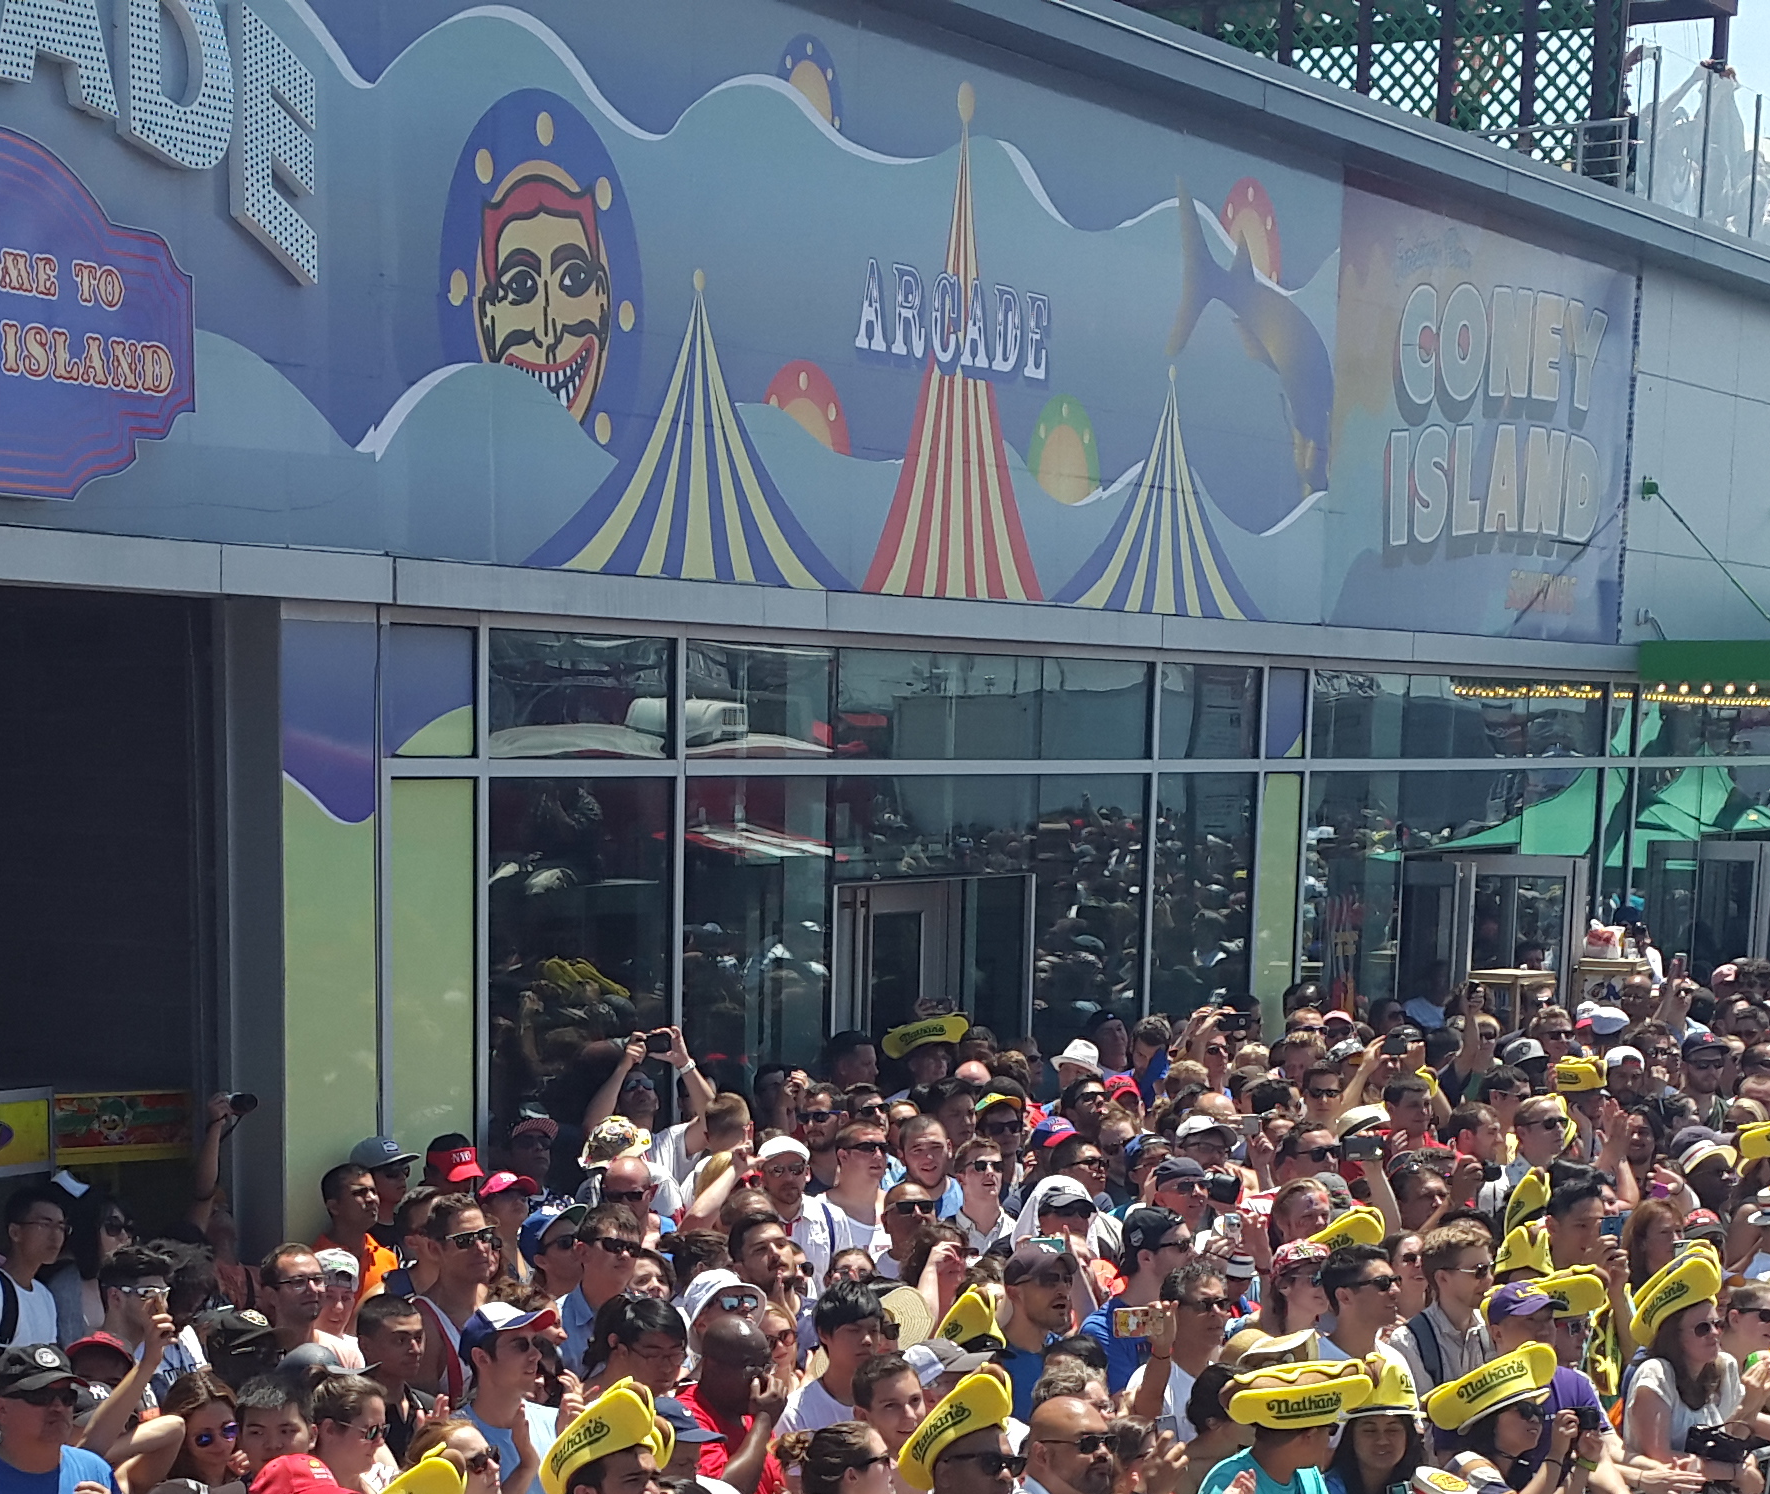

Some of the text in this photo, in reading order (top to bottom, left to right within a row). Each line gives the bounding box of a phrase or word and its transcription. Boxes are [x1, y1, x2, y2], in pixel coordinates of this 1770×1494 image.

[73, 260, 125, 312] TO
[854, 258, 1052, 382] ARCADE
[1396, 281, 1610, 414] CONEY
[0, 318, 176, 398] ISLAND
[1386, 422, 1601, 549] ISLAND
[1266, 1391, 1343, 1421] Nathan's
[1456, 1359, 1528, 1404] Nathan's
[550, 1416, 611, 1480] Nathan's
[912, 1401, 972, 1462] Nathan's
